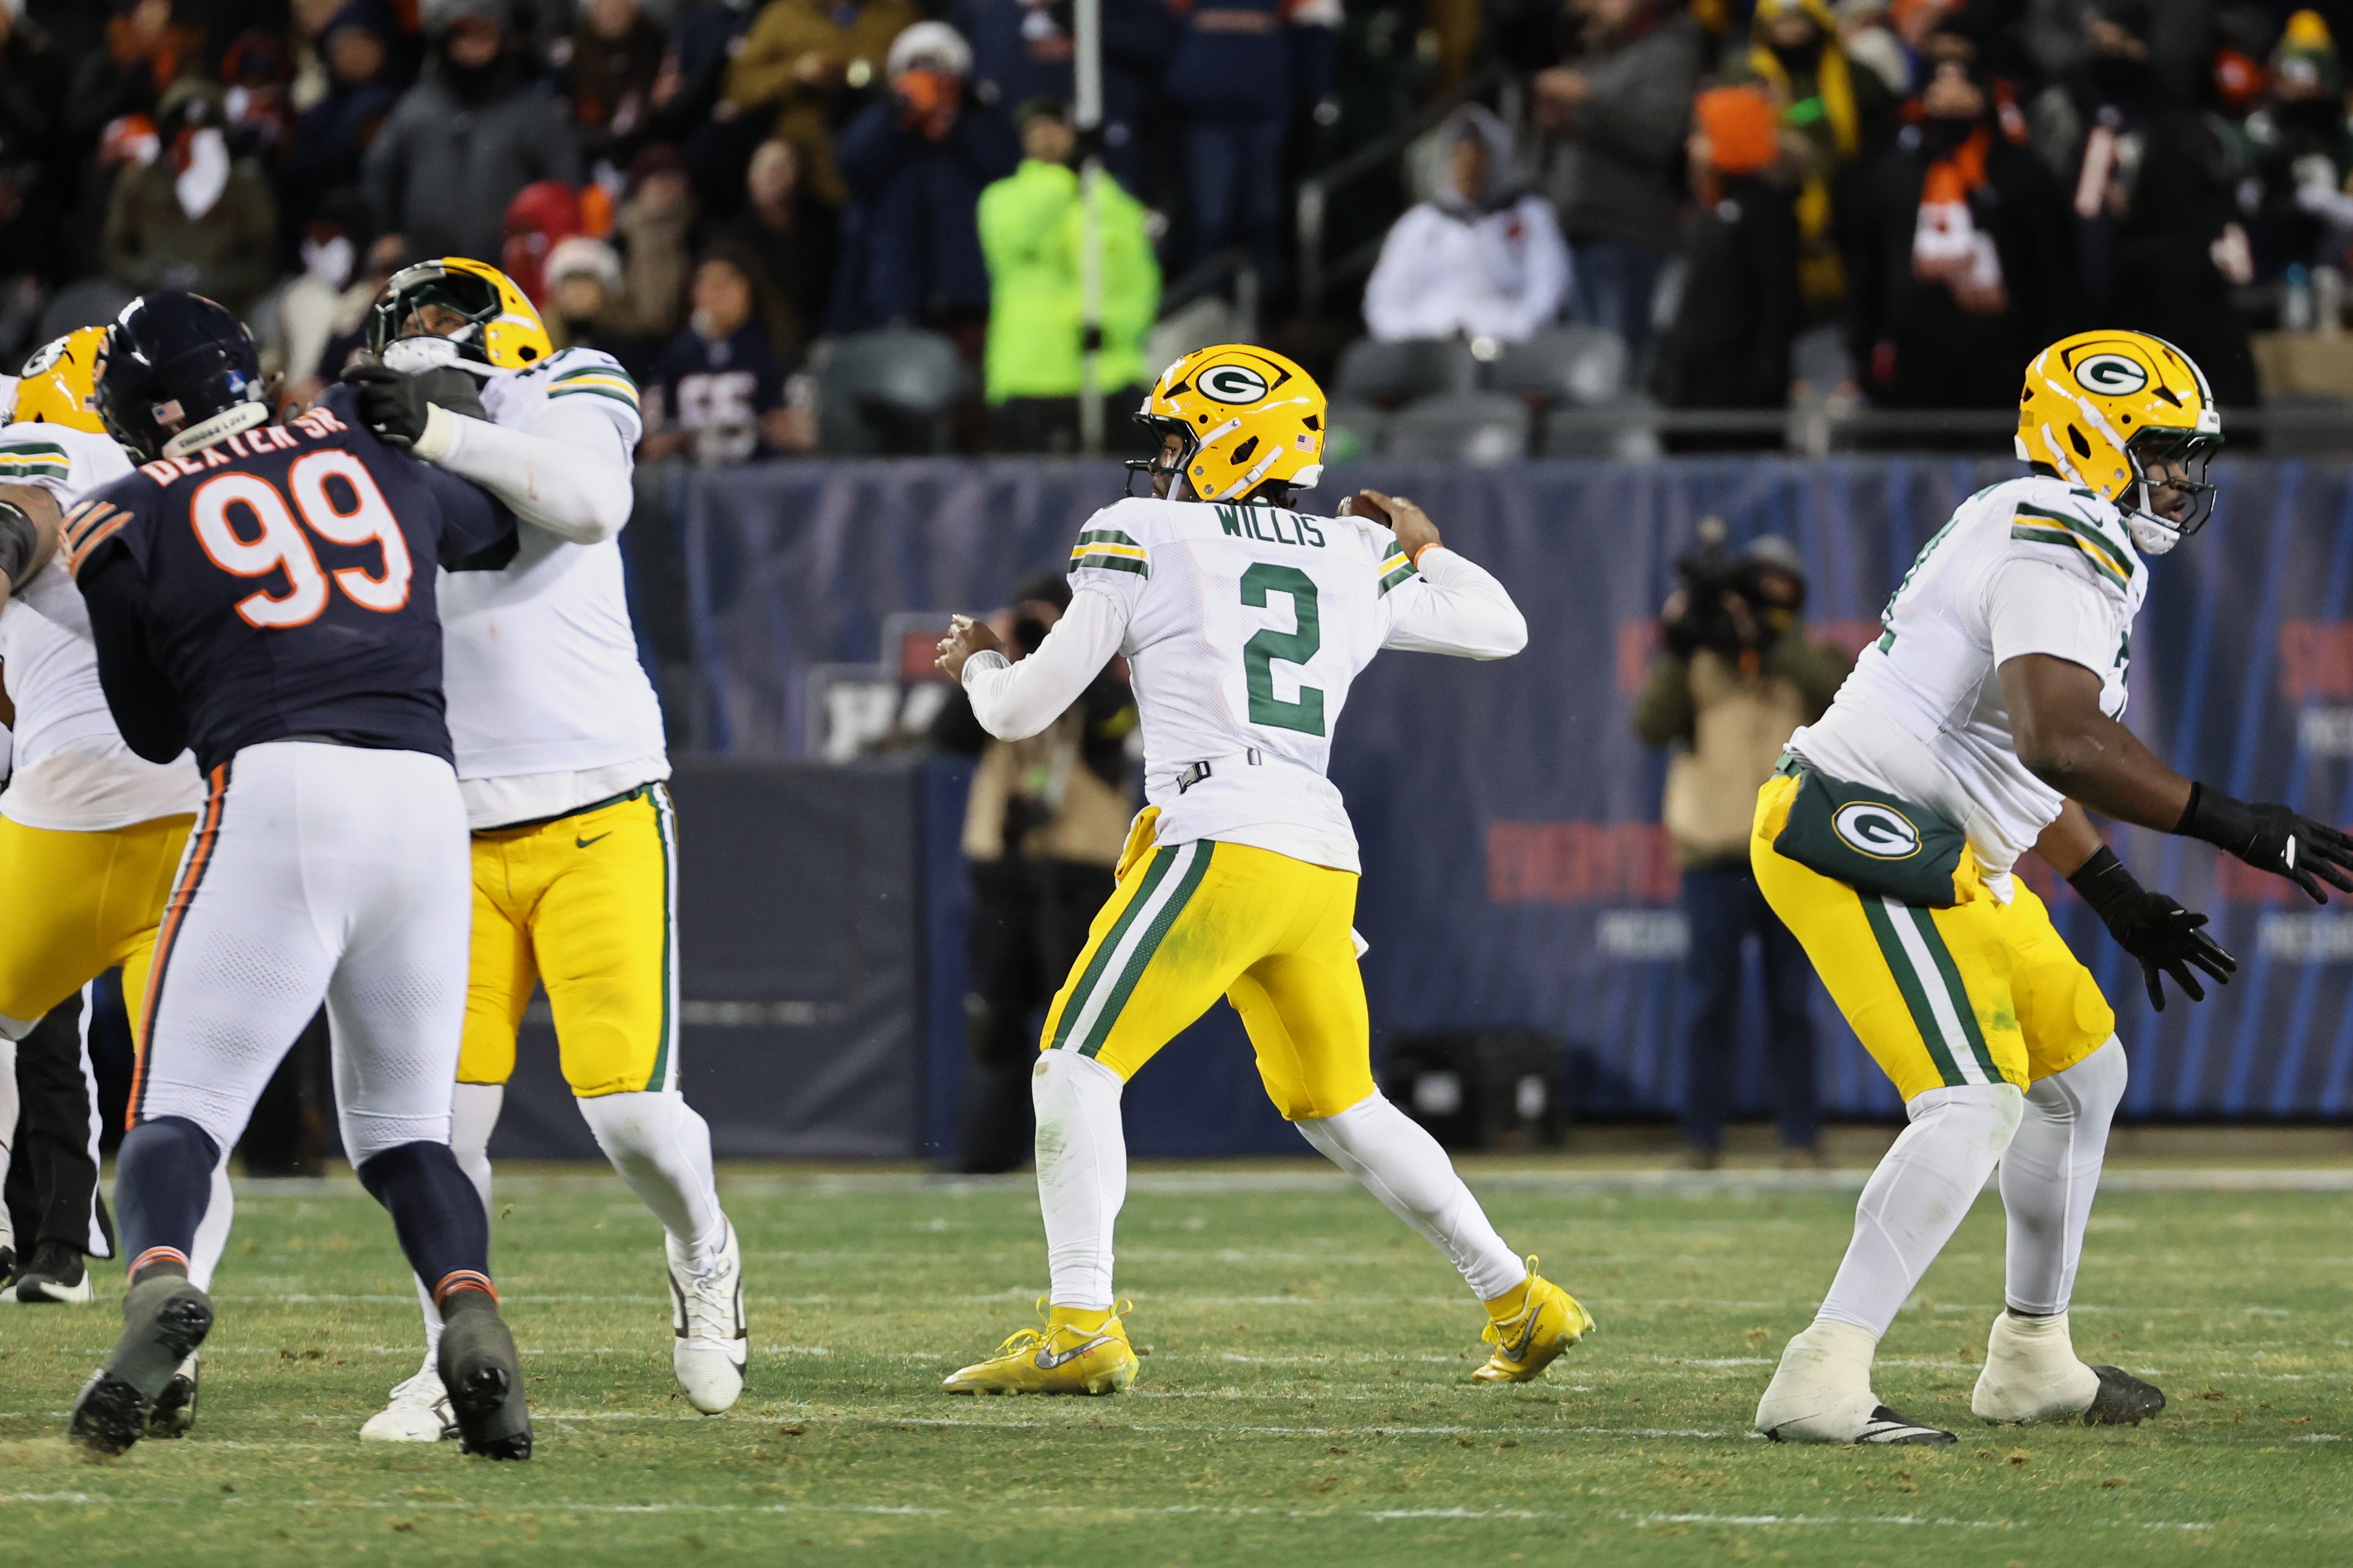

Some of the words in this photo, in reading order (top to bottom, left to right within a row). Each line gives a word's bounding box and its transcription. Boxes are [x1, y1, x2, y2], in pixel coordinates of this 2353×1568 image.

[1197, 364, 1268, 404] G
[2076, 354, 2147, 395] G
[190, 448, 414, 628] 99
[1213, 505, 1325, 547] WILLIS
[1240, 562, 1325, 737] 2
[1834, 803, 1920, 858] G
